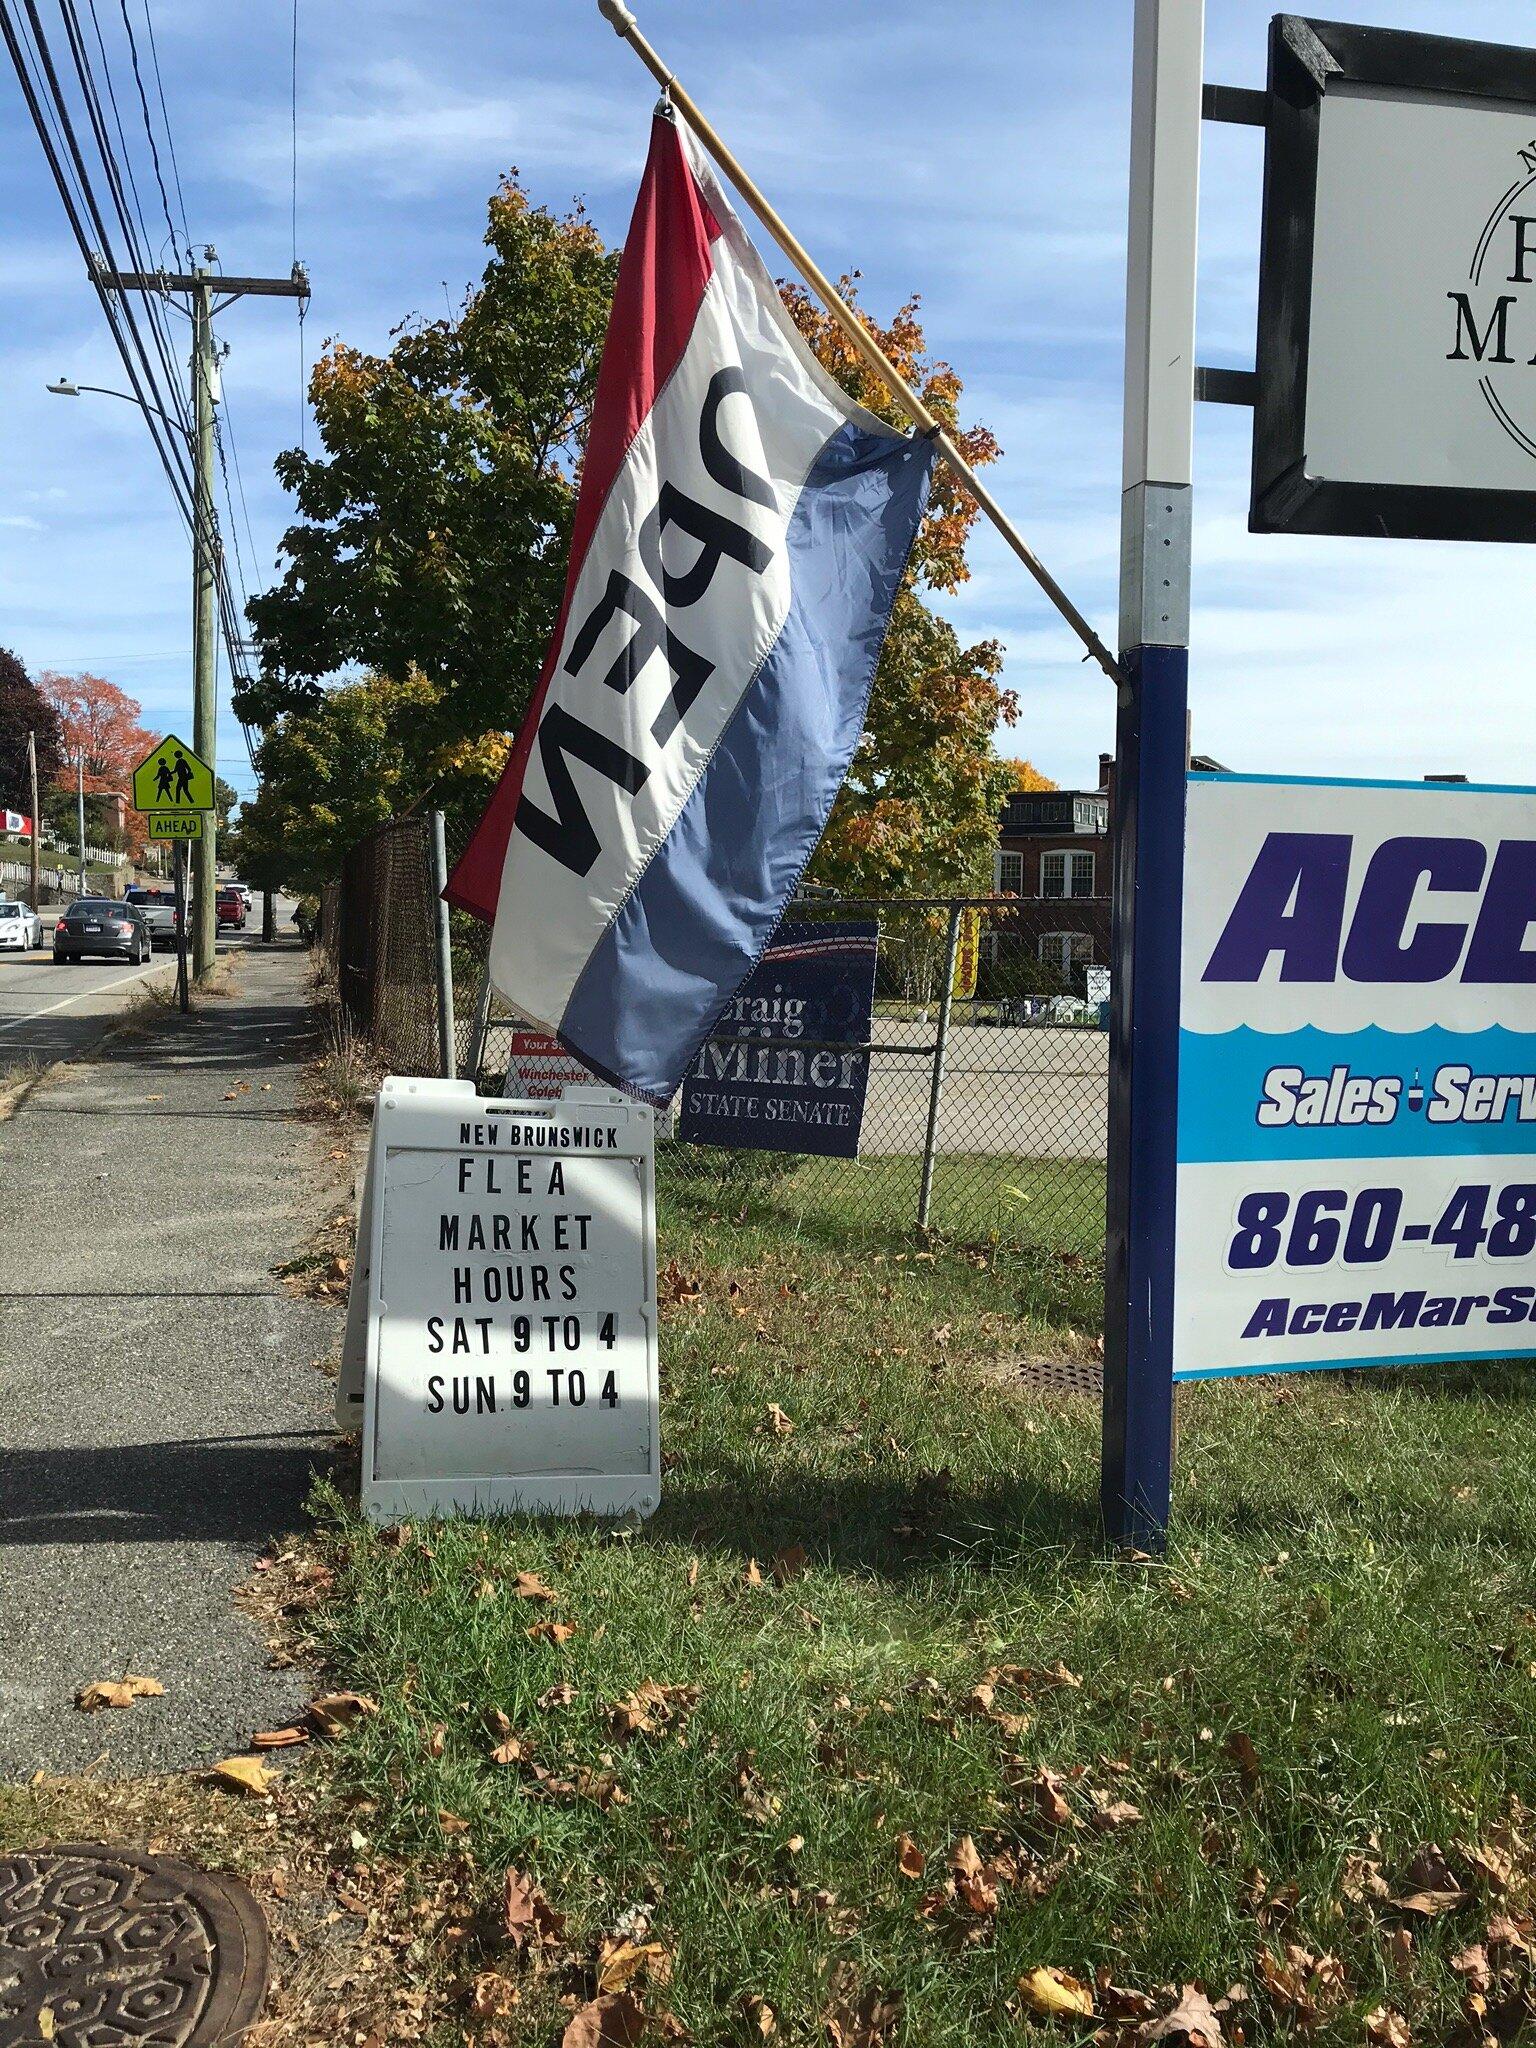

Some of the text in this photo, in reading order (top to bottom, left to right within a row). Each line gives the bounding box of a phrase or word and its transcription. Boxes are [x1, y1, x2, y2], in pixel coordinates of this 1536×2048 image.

[1445, 290, 1536, 367] M
[155, 818, 197, 835] AHEAD
[523, 1038, 548, 1051] Your
[691, 1026, 864, 1090] Miner
[517, 1065, 589, 1081] Winchester
[689, 1092, 851, 1127] STATE SENATE
[1257, 1065, 1401, 1127] Sales
[460, 1123, 617, 1149] NEW BRUNSWICK
[458, 1158, 565, 1196] FLEA
[439, 1214, 592, 1251] MARKET
[453, 1265, 577, 1304] HOURS
[1241, 1286, 1536, 1340] AceMarS
[427, 1312, 616, 1354] SAT 9 TO 4
[513, 1370, 530, 1408] 9
[546, 1369, 586, 1407] TO
[601, 1370, 619, 1408] 4
